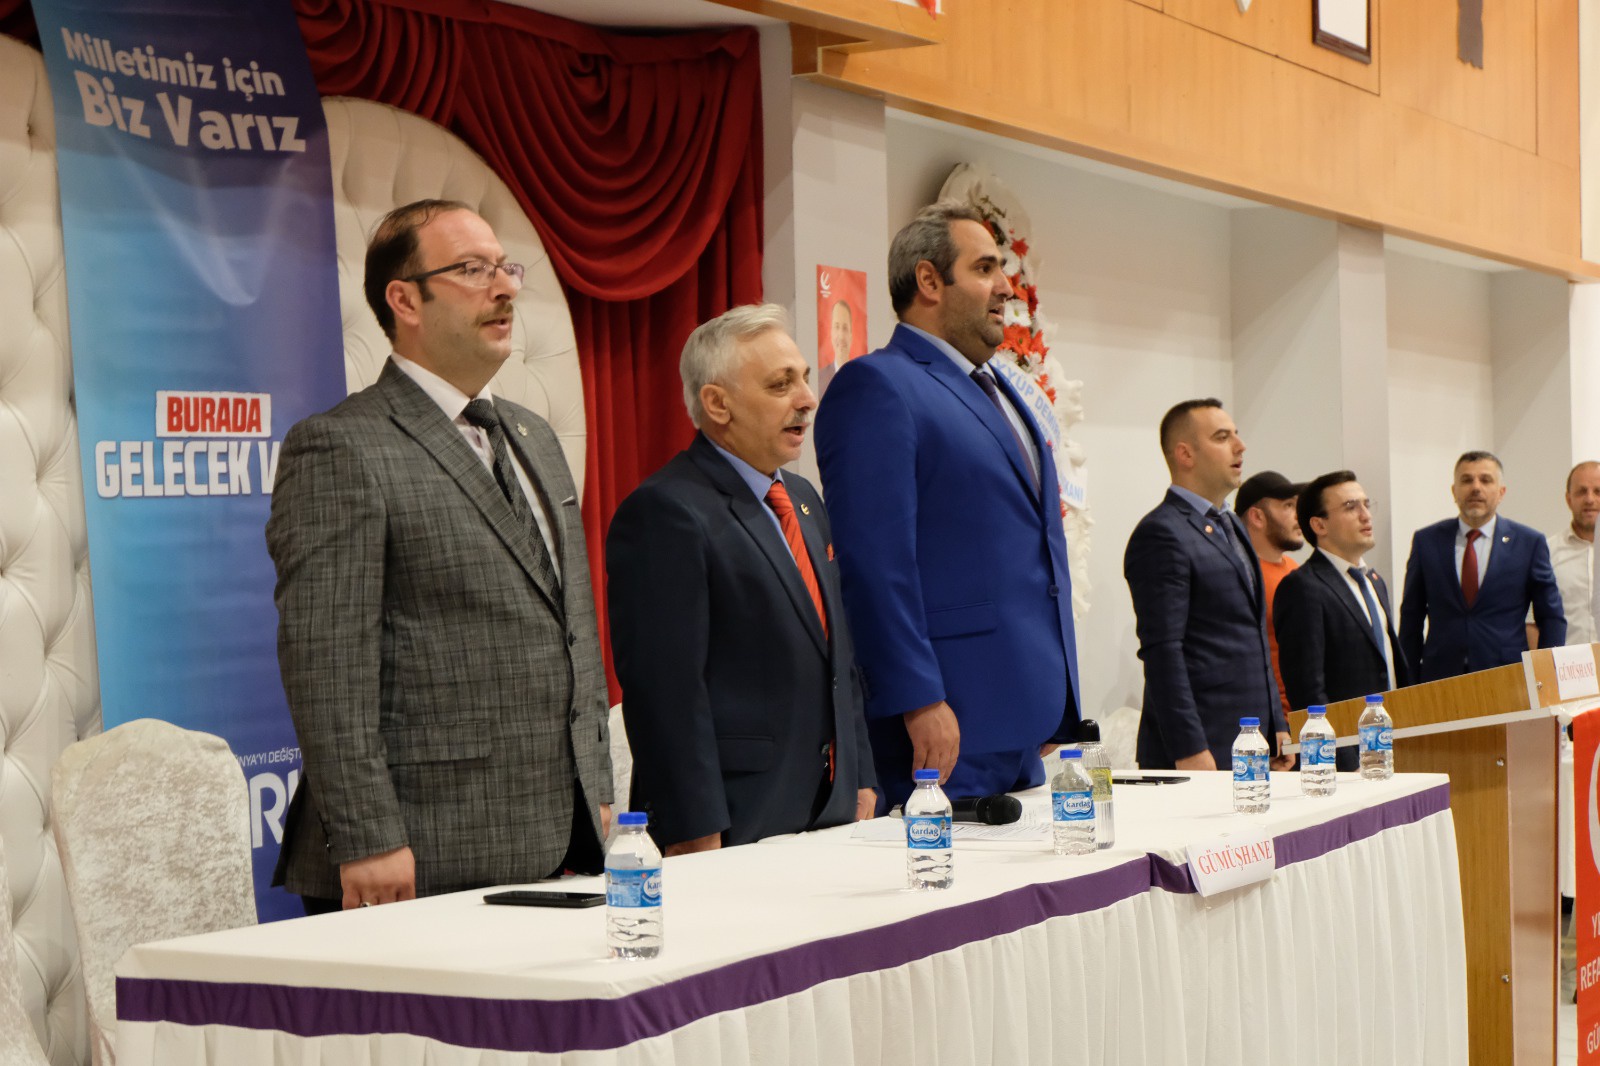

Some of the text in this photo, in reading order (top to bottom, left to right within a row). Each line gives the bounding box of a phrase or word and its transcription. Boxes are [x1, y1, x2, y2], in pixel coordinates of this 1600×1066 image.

[61, 27, 286, 101] Milletimiz için
[74, 69, 306, 152] Biz Varız
[166, 396, 262, 432] BURADA
[95, 440, 251, 498] GELECEK
[1198, 840, 1273, 875] GÜMÜŞHANE
[1587, 1021, 1600, 1054] GÜ
